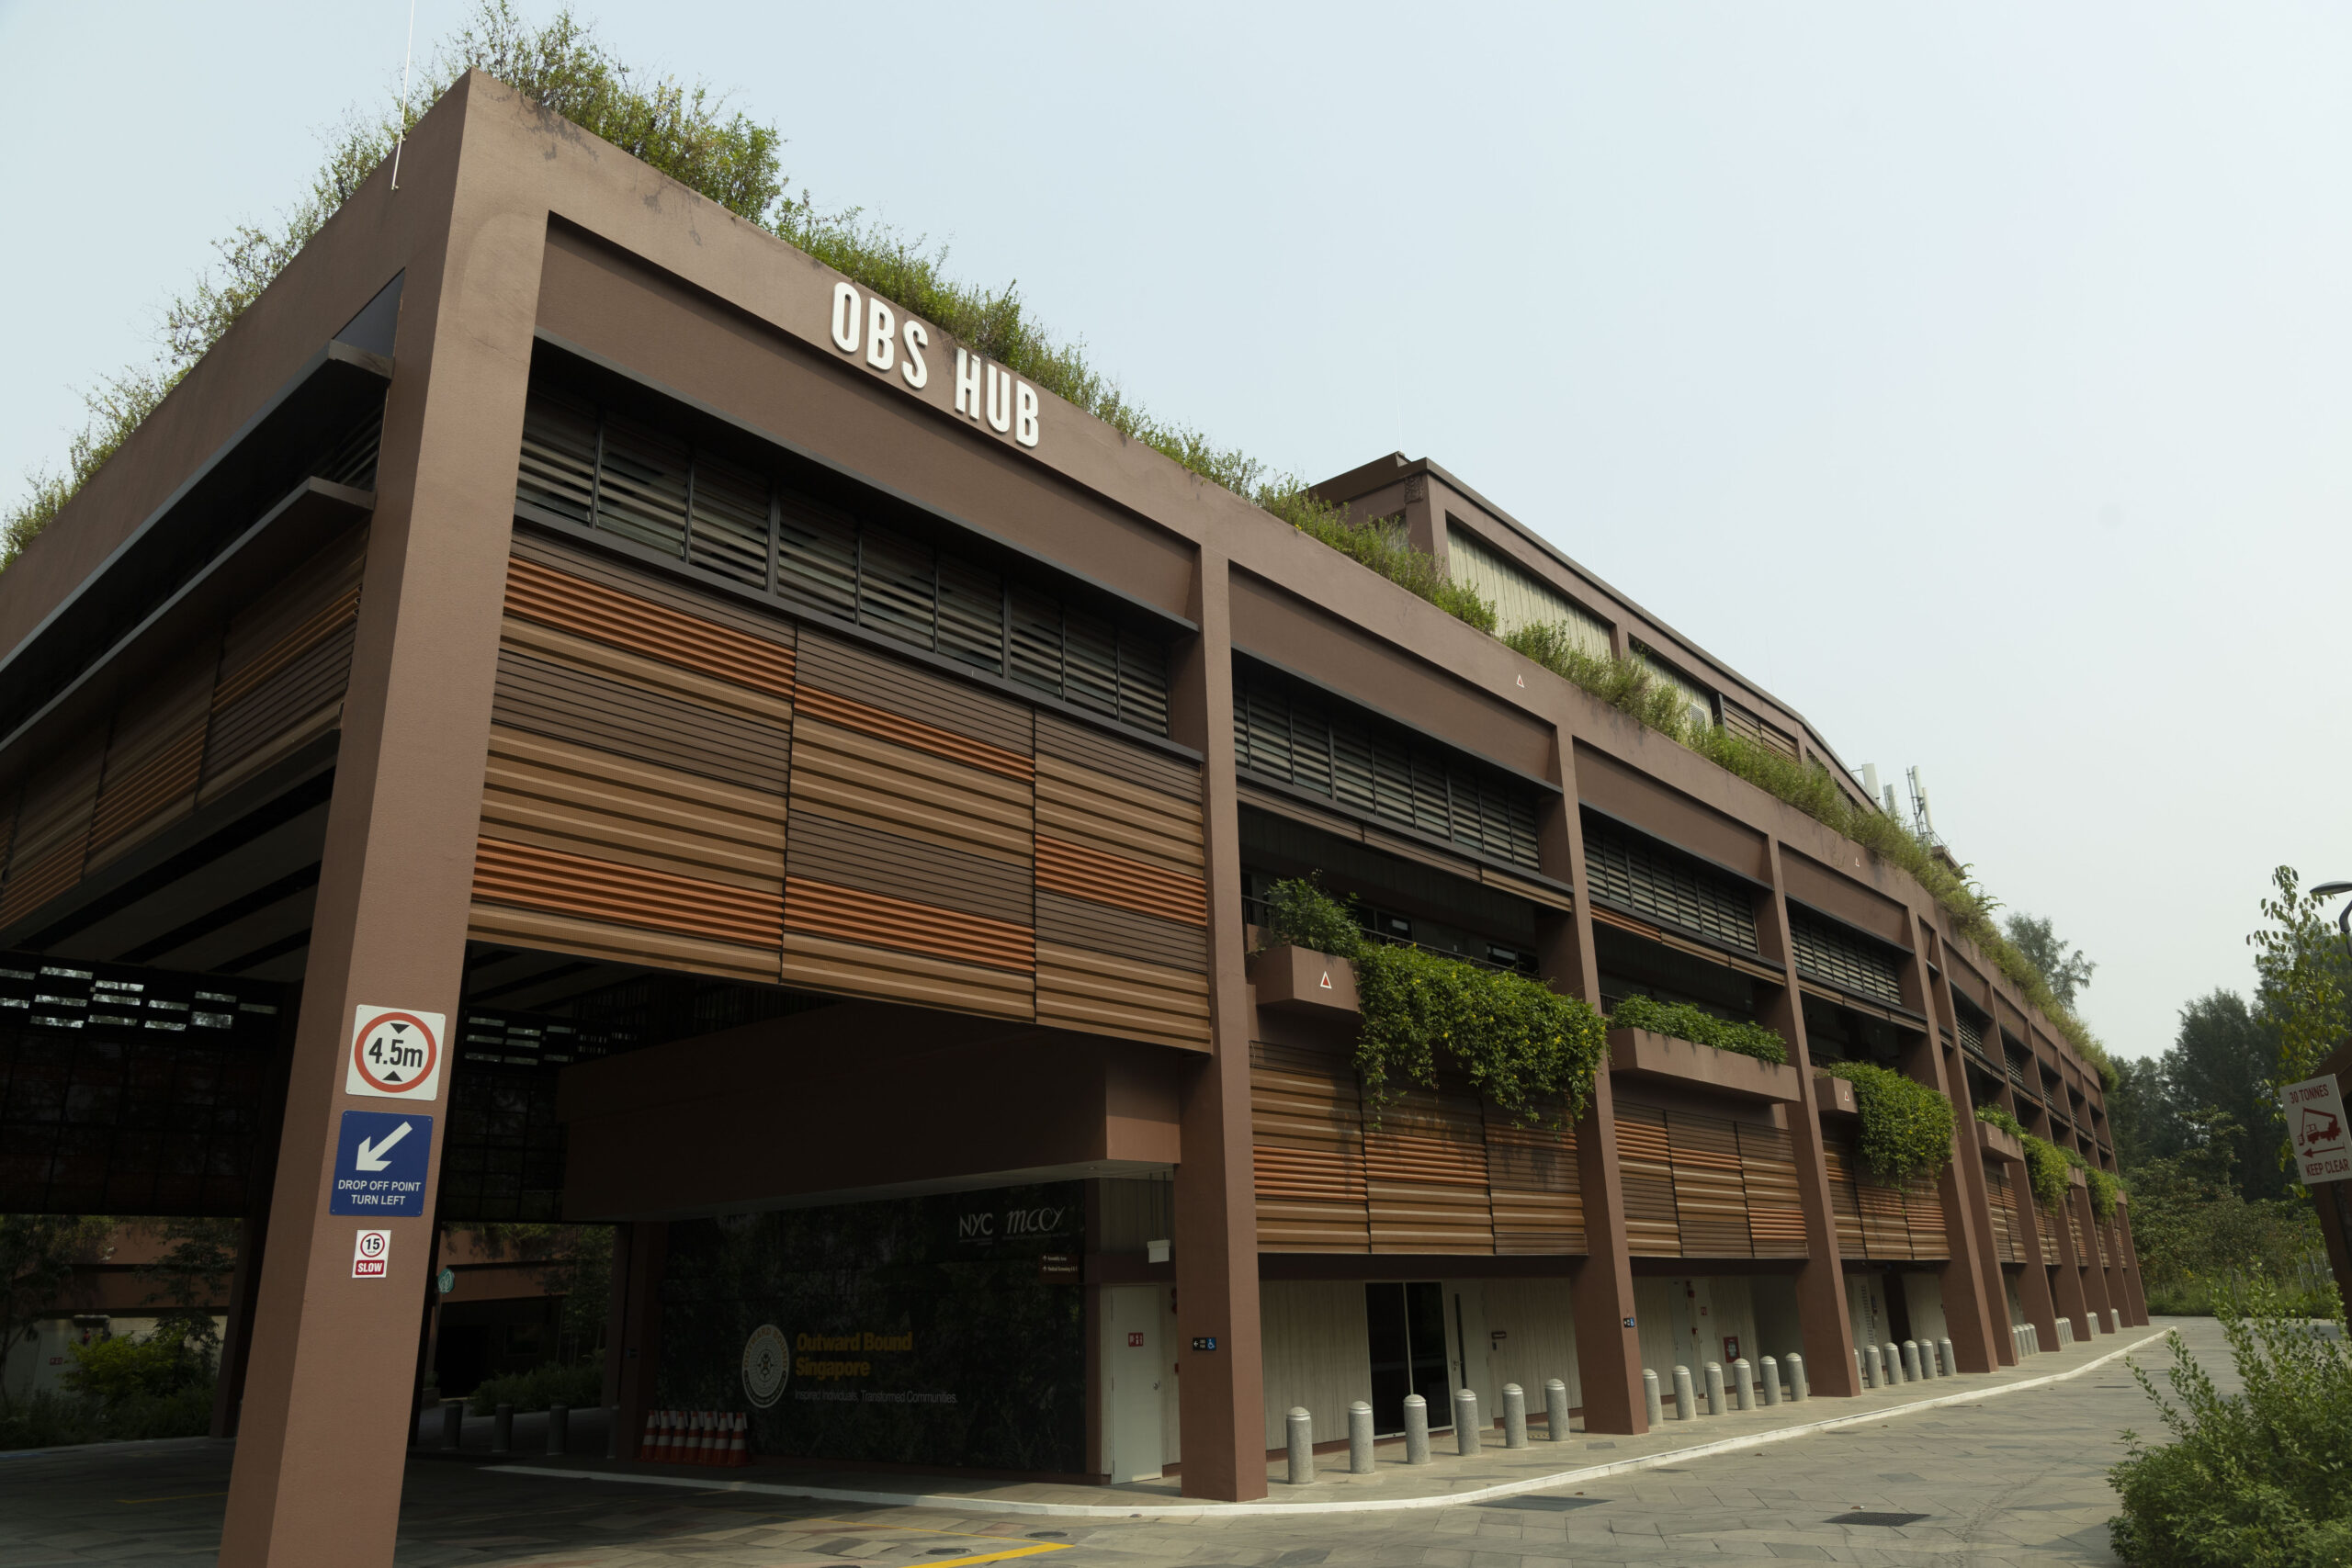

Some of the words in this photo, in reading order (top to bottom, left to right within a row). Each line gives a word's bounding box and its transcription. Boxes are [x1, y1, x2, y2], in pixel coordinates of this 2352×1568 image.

[831, 282, 928, 389] OBS
[955, 347, 1039, 447] HUB
[368, 1037, 424, 1067] 4.5m
[2290, 1091, 2299, 1103] 30
[2299, 1085, 2329, 1100] TONNES
[2306, 1163, 2324, 1176] KEEP
[2325, 1159, 2349, 1173] CLEAR
[338, 1179, 368, 1190] DROP
[369, 1180, 390, 1191] OFF
[391, 1181, 422, 1192] POINT
[352, 1194, 379, 1205] TURN
[381, 1195, 406, 1206] LEFT
[959, 1213, 992, 1237] NYC
[366, 1238, 380, 1250] 15
[357, 1262, 383, 1272] SLOW
[797, 1333, 860, 1352] Outward
[864, 1331, 912, 1352] Bound
[796, 1358, 870, 1380] Singapore
[795, 1389, 820, 1403] Inspired
[822, 1389, 859, 1404] Individuals,
[860, 1389, 905, 1404] Transformed
[906, 1390, 958, 1404] Communities.
